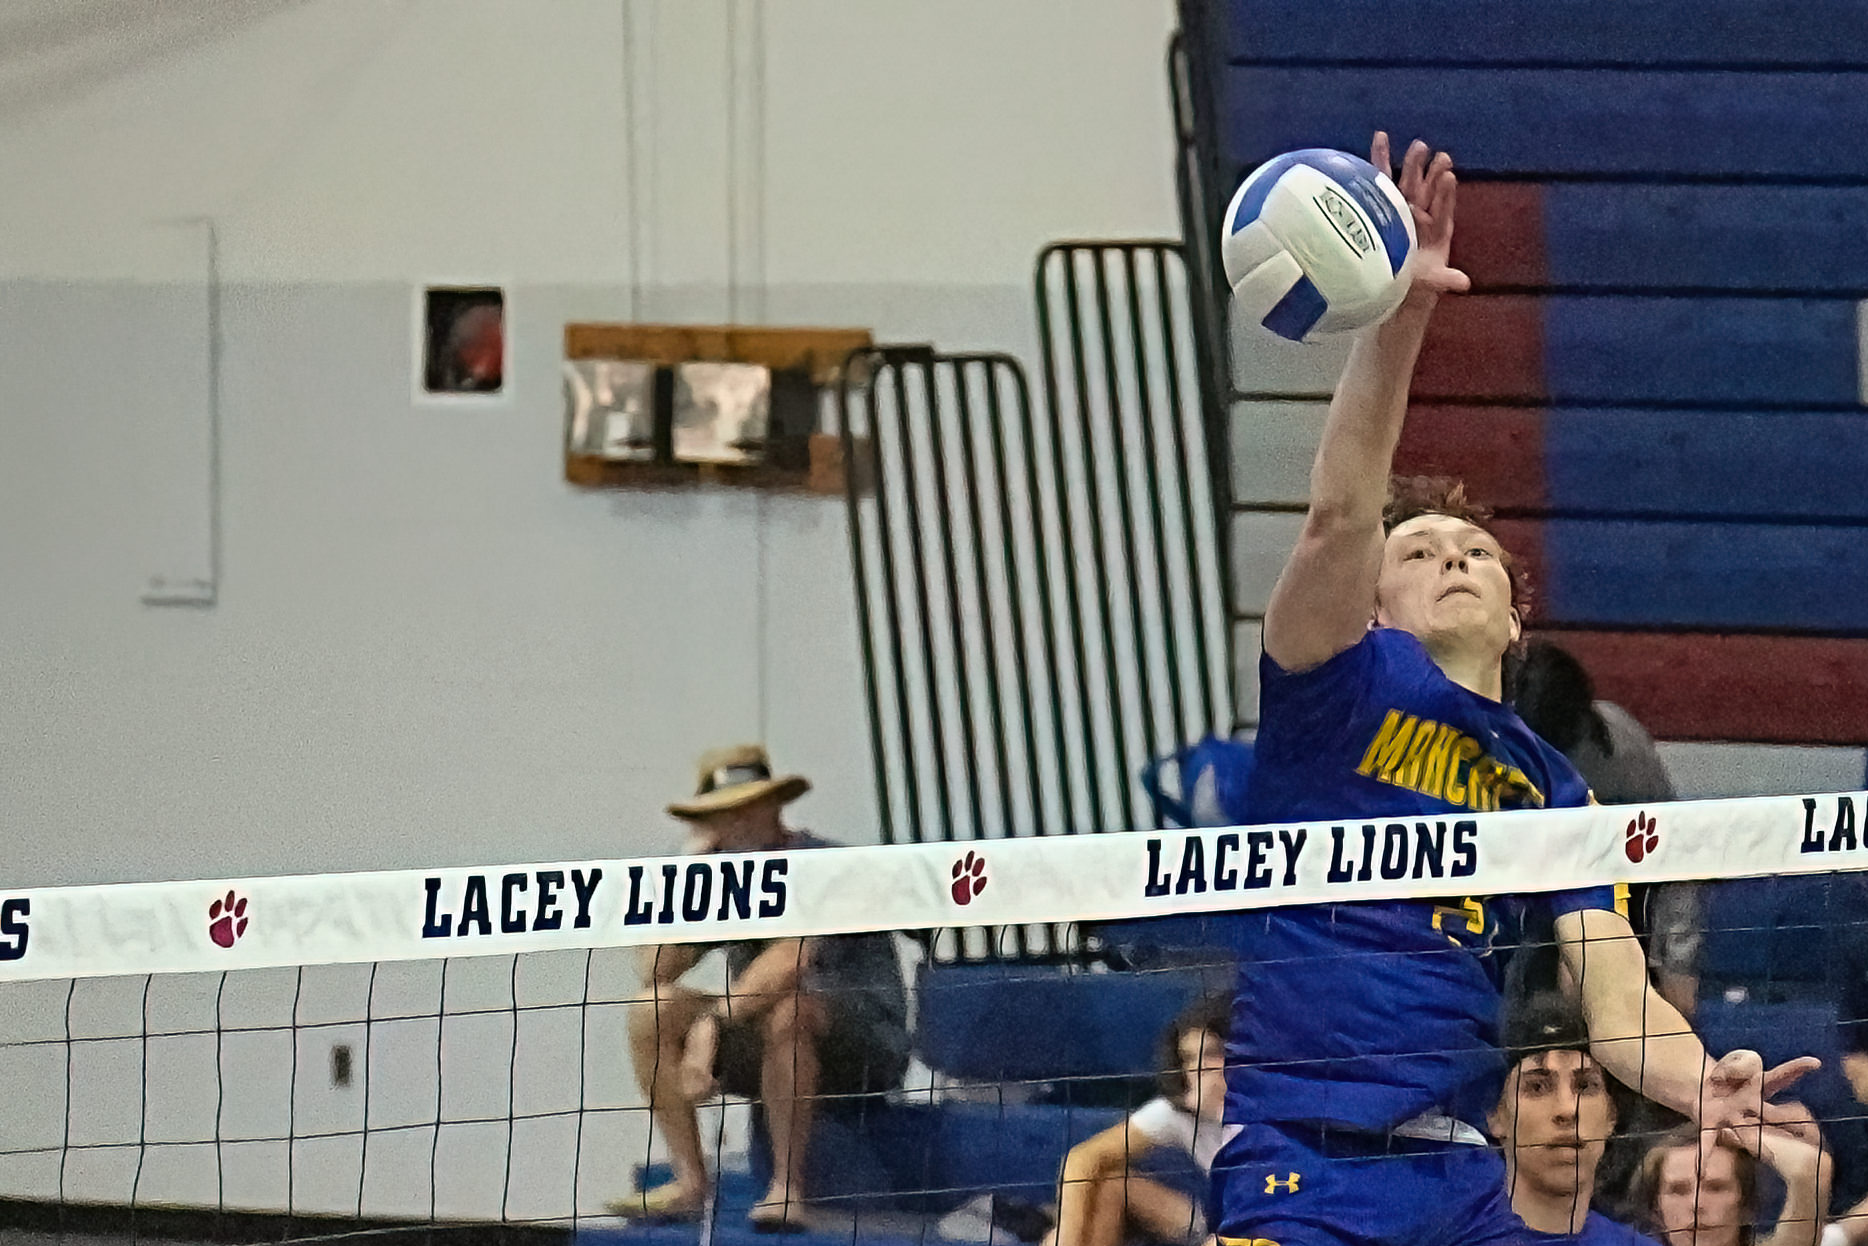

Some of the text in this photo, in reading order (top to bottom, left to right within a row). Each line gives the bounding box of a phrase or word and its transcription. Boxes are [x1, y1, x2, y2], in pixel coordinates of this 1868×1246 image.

[1145, 820, 1478, 898] LACEY LIONS
[423, 859, 788, 939] LACEY LIONS
